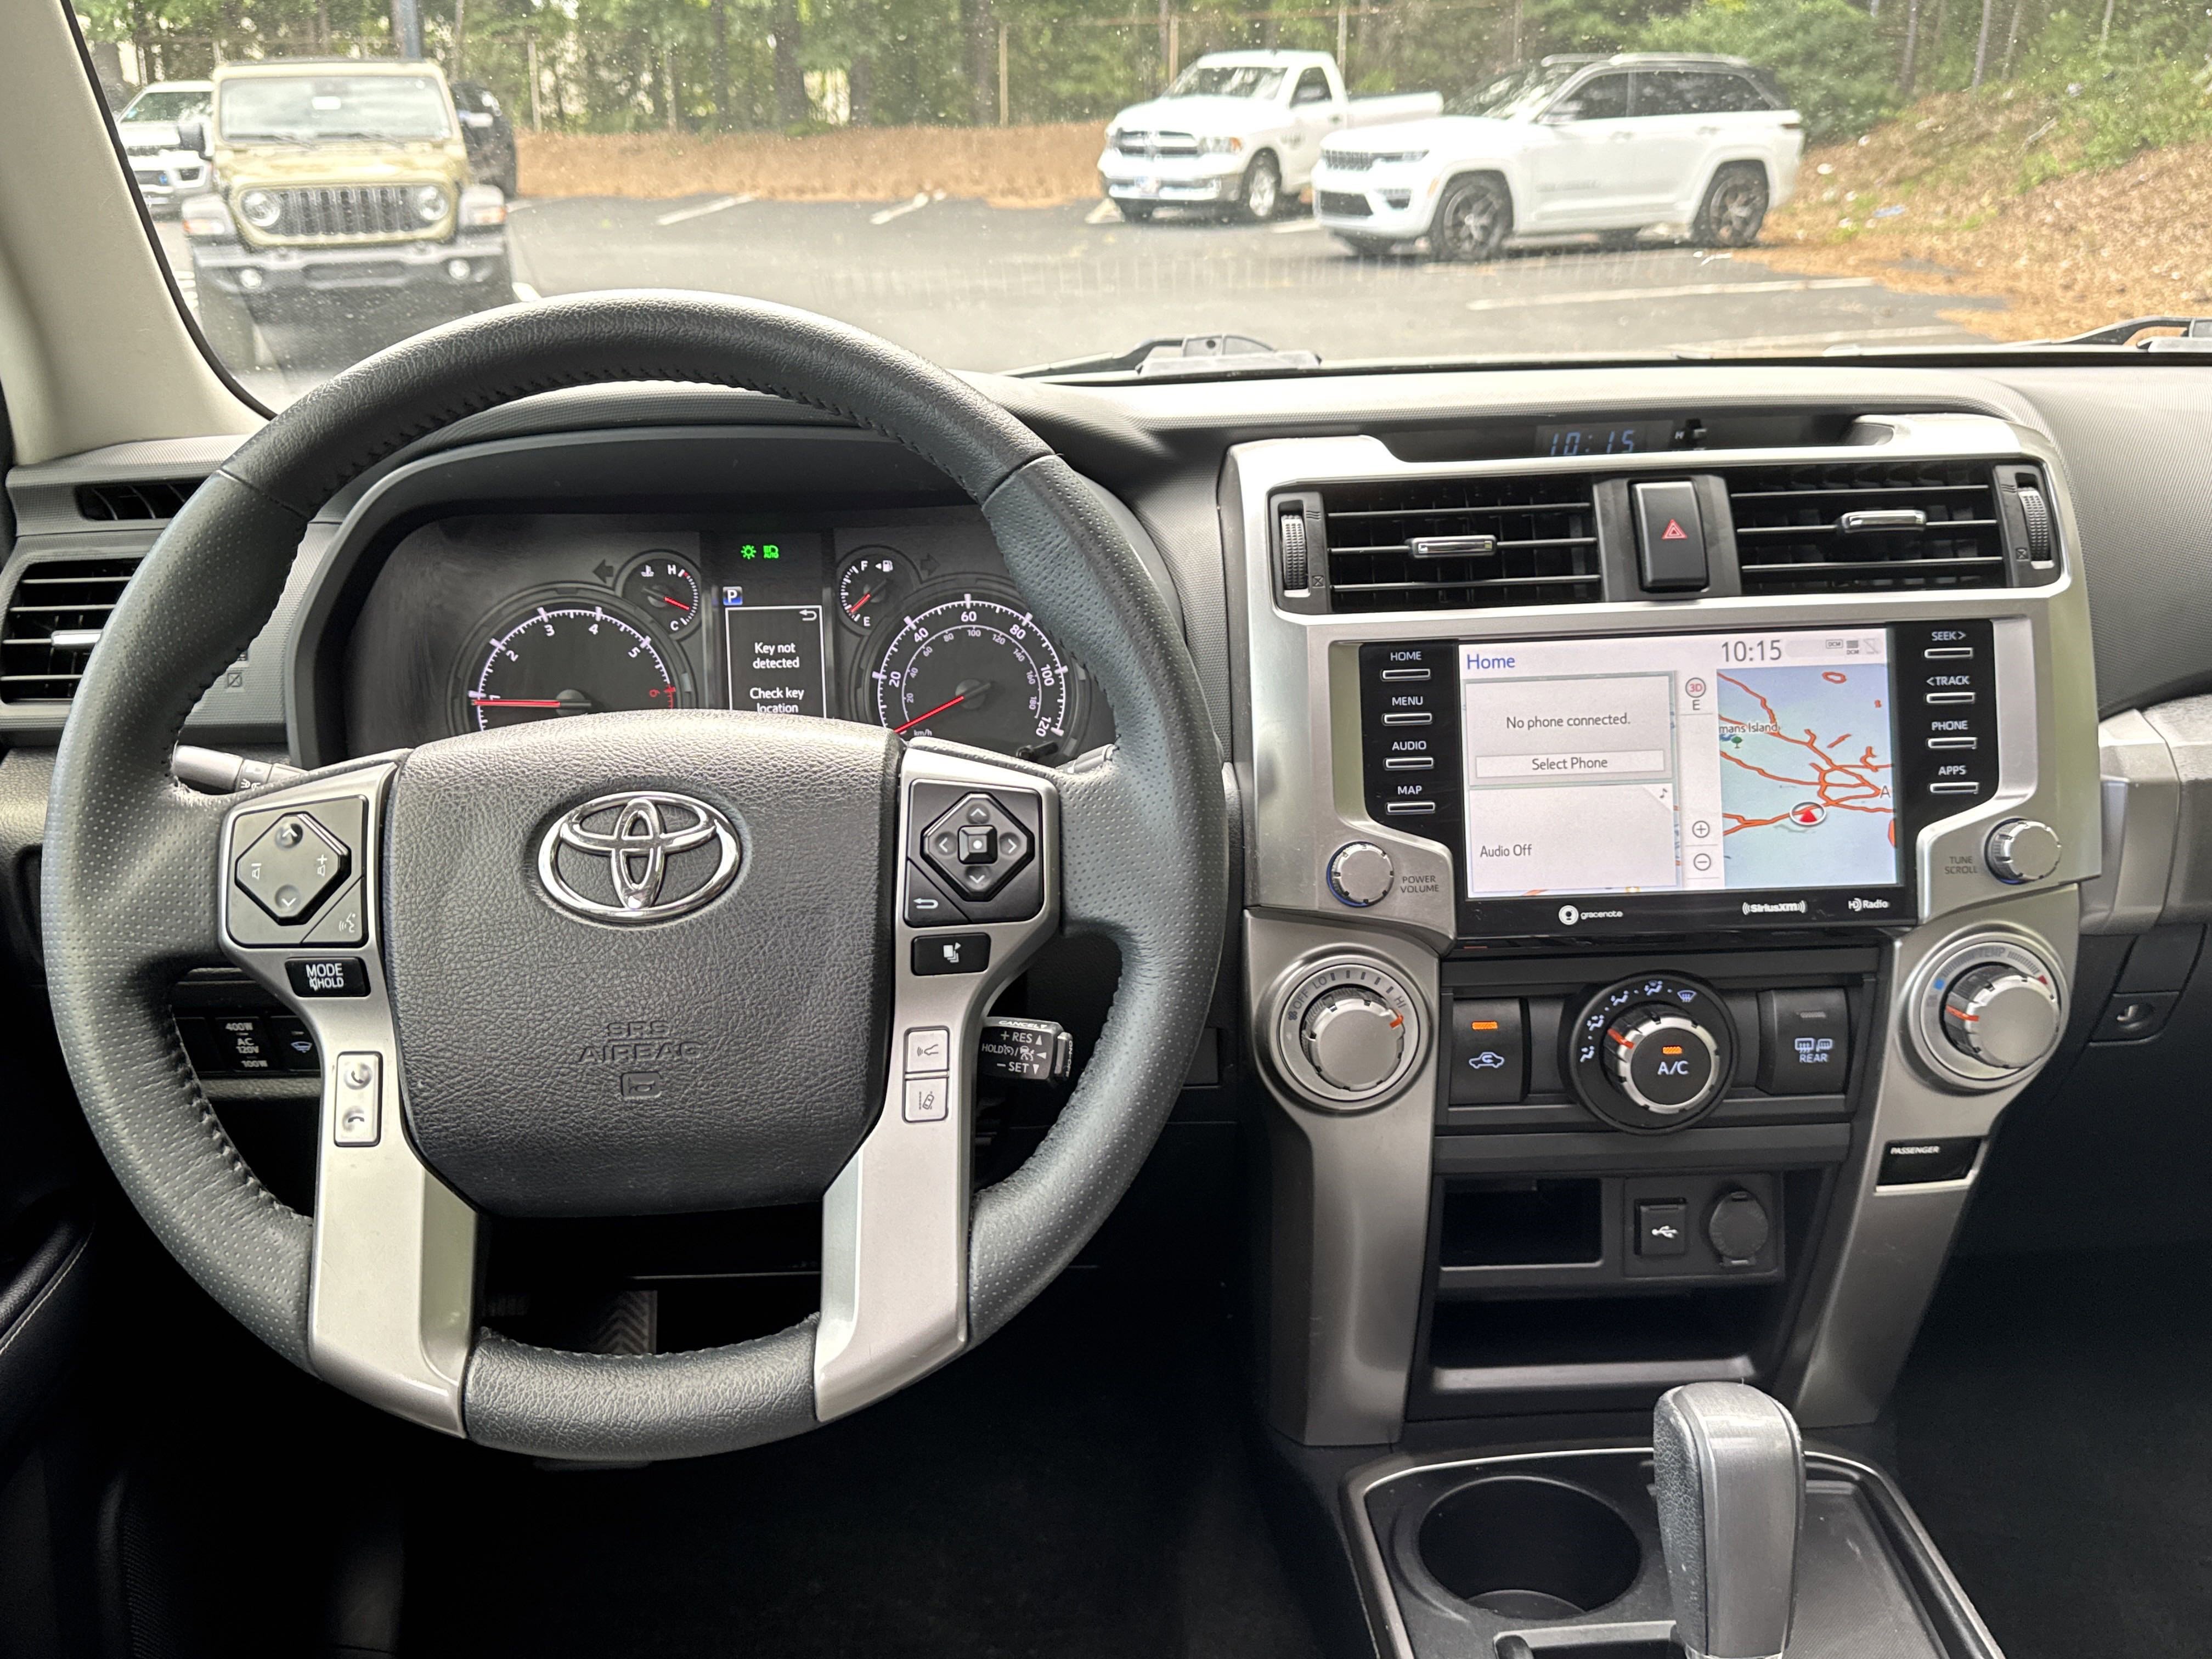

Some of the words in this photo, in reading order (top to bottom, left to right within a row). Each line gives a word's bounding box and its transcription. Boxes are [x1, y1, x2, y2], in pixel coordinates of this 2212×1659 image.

[1551, 431, 1634, 456] 10:15
[668, 565, 675, 575] H
[861, 561, 868, 571] F
[727, 590, 737, 602] P
[864, 616, 871, 627] E
[961, 611, 977, 622] 60
[545, 625, 555, 636] 3
[589, 624, 599, 635] 4
[671, 620, 679, 630] C
[913, 628, 929, 642] 40
[943, 633, 954, 642] 80
[967, 629, 981, 637] 100
[1009, 624, 1026, 640] 80
[992, 634, 1006, 645] 120
[628, 647, 640, 658] 5
[755, 642, 775, 655] Key
[777, 642, 795, 653] not
[922, 646, 933, 657] 60
[1722, 640, 1782, 662] 10:15
[506, 650, 518, 661] 2
[1013, 648, 1025, 662] 140
[1391, 651, 1421, 661] HOME
[753, 657, 799, 669] detected
[1466, 654, 1515, 670] Home
[909, 667, 918, 679] 40
[1026, 670, 1035, 685] 160
[1040, 664, 1055, 686] 100
[889, 671, 902, 687] 20
[750, 687, 783, 699] Check
[785, 687, 804, 699] key
[1689, 684, 1702, 692] 3D
[907, 693, 913, 703] 20
[1029, 696, 1037, 710] 180
[1392, 696, 1423, 706] MENU
[757, 703, 798, 713] location
[1692, 699, 1700, 710] E
[1035, 716, 1052, 737] 120
[1506, 716, 1524, 729] No
[1527, 715, 1563, 730] phone
[1567, 713, 1630, 727] connected.
[1931, 720, 1968, 730] PHONE
[1748, 723, 1778, 732] Island
[1392, 741, 1426, 751] AUDIO
[1532, 758, 1567, 771] Select
[1571, 756, 1608, 769] Phone
[1938, 766, 1966, 775] APPS
[1397, 785, 1422, 795] MAP
[1480, 845, 1510, 857] Audio
[1513, 844, 1532, 856] Off
[1950, 856, 1973, 865] TUNE
[1944, 865, 1977, 874] SCROLL
[1402, 876, 1436, 884] POWER
[1400, 884, 1440, 893] VOLUME
[1863, 900, 1888, 909] Radio
[1581, 910, 1623, 919] gracenote
[1977, 947, 2006, 958] TEMP
[306, 964, 343, 977] MODE
[318, 977, 344, 988] HOLD
[1312, 977, 1327, 989] LO
[1294, 990, 1310, 1009] OFF
[1394, 995, 1406, 1008] HI
[225, 1023, 253, 1031] 400W
[607, 1021, 670, 1036] SRS
[999, 1020, 1039, 1029] CANCEL
[1012, 1032, 1032, 1043] RES
[578, 1042, 701, 1062] AIRBAG
[981, 1043, 1003, 1053] HOLD
[1799, 1053, 1827, 1063] REAR
[1008, 1062, 1030, 1073] SET
[1657, 1060, 1689, 1075] A/C
[1891, 1146, 1940, 1155] PASSENGER
